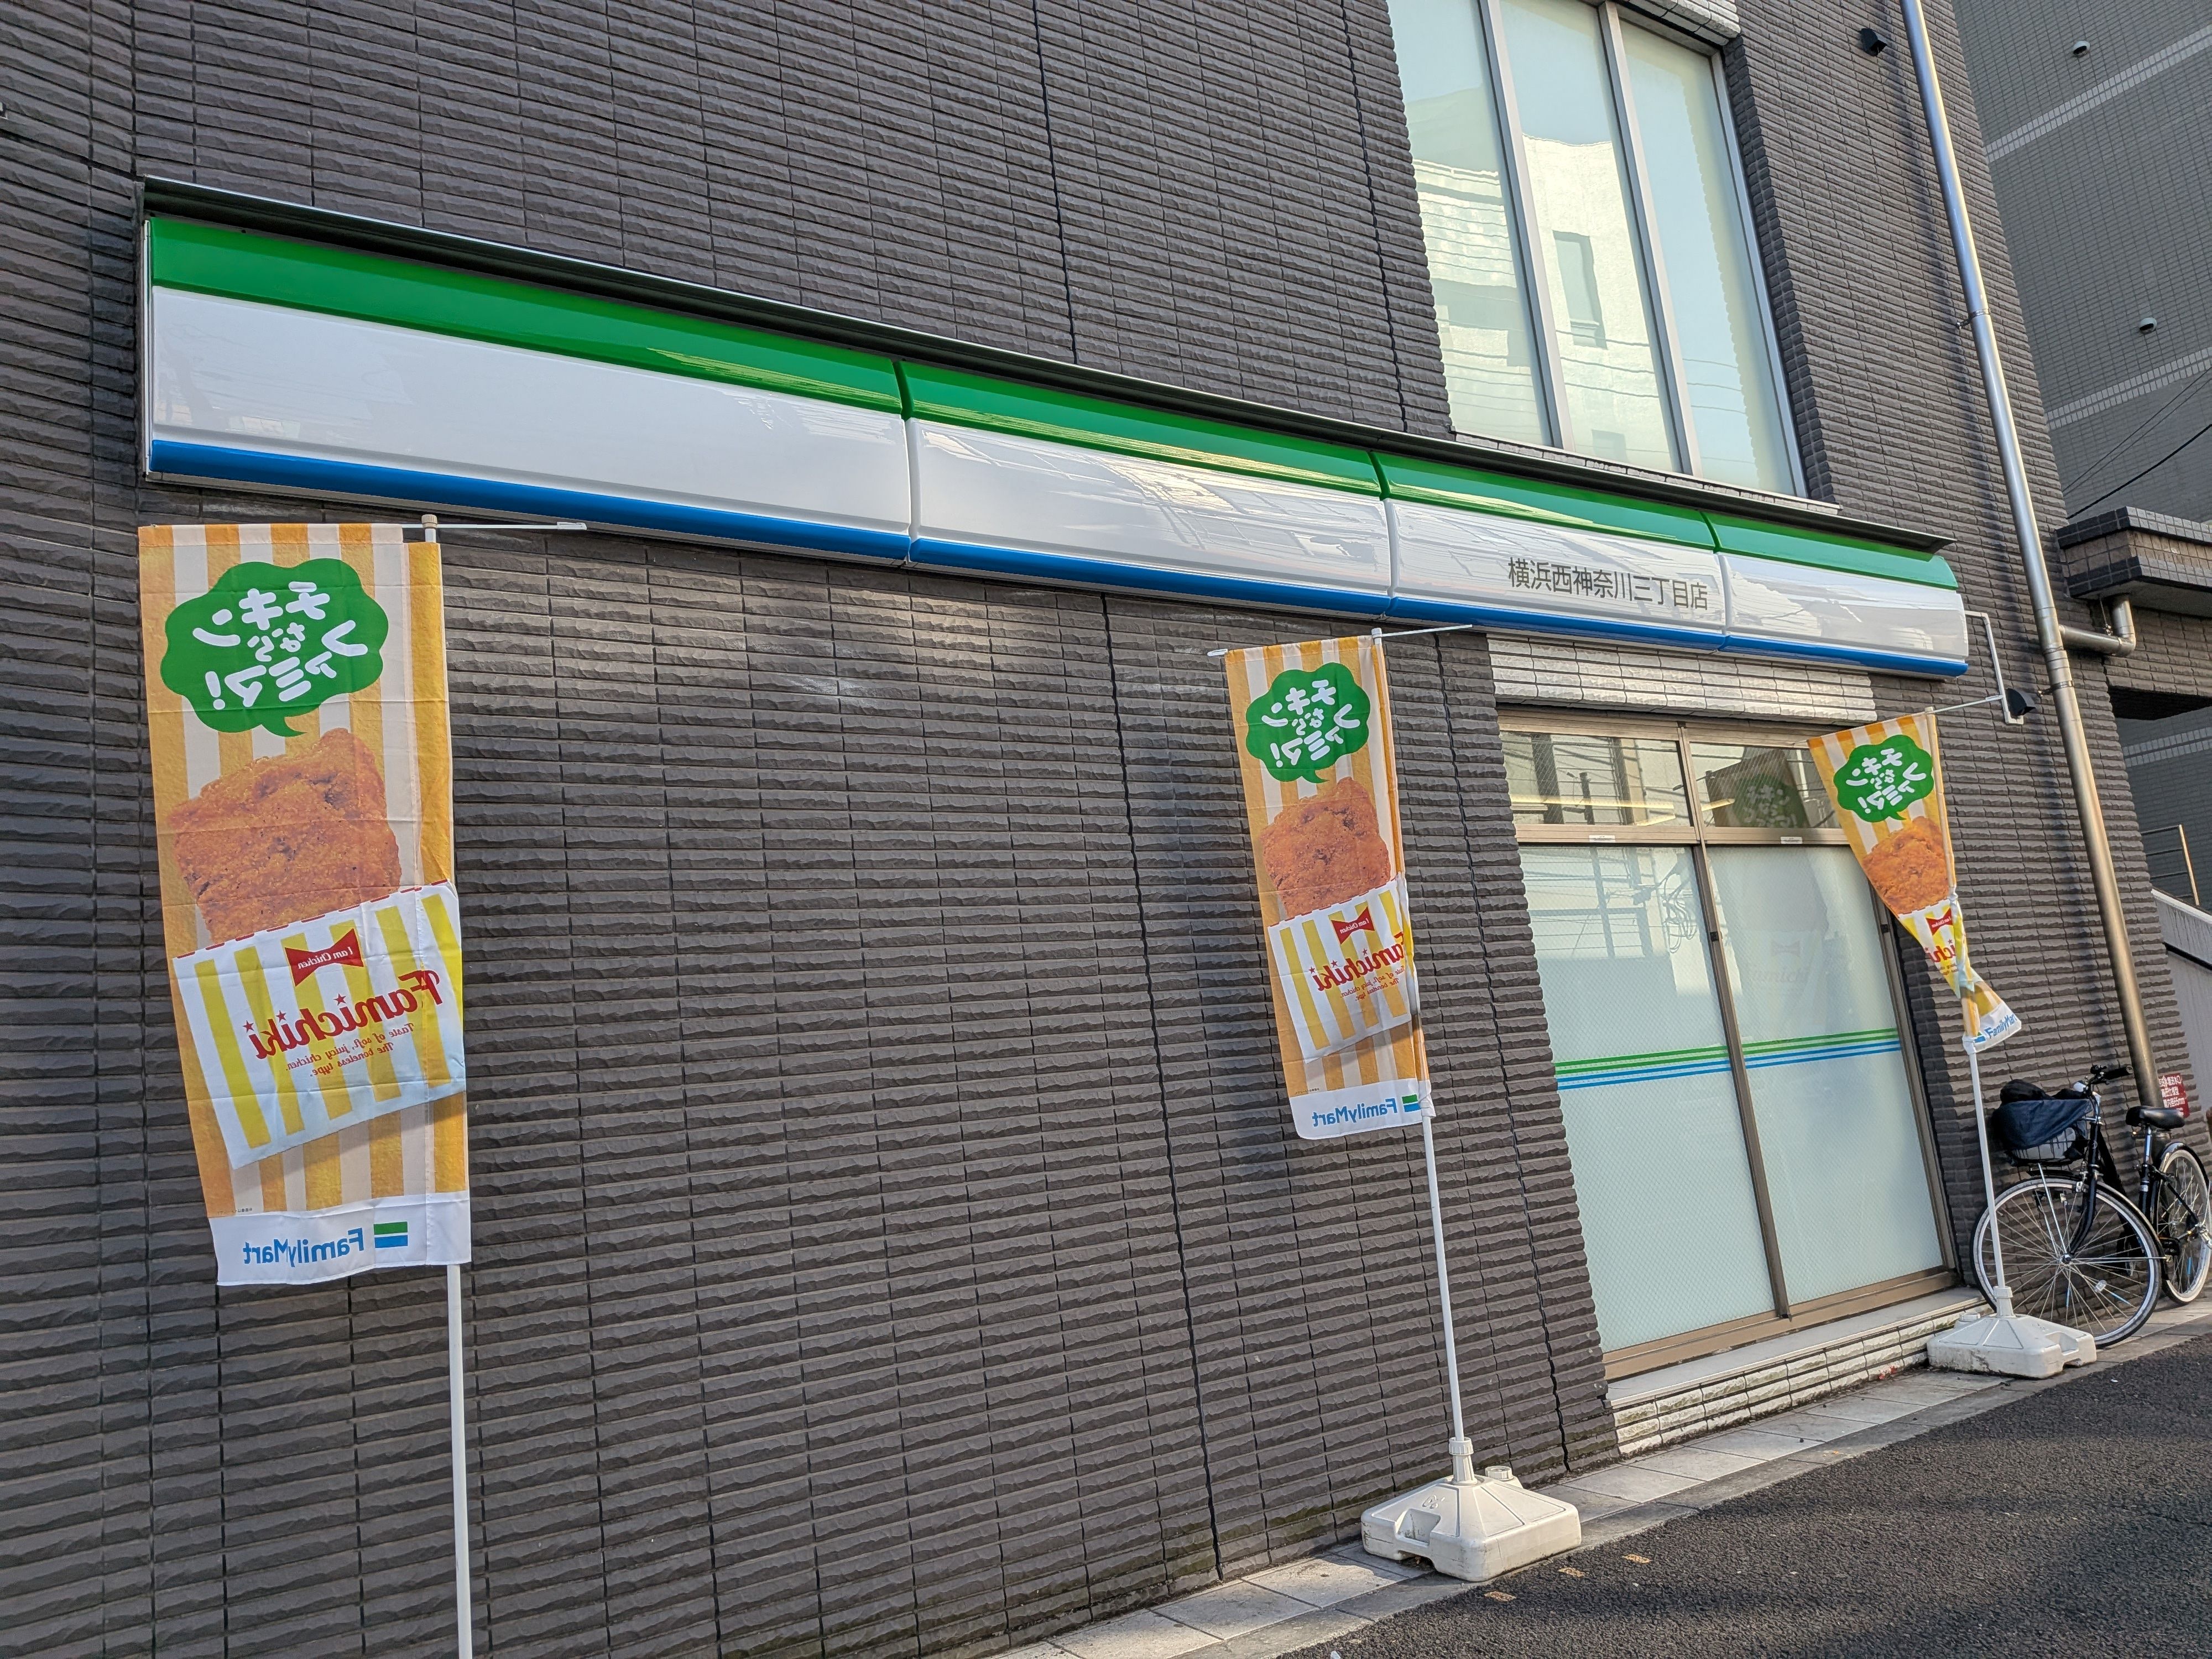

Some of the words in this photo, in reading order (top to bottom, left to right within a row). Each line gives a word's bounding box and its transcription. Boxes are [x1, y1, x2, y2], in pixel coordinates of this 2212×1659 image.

[1508, 557, 1708, 611] 横浜西神奈川三丁目店
